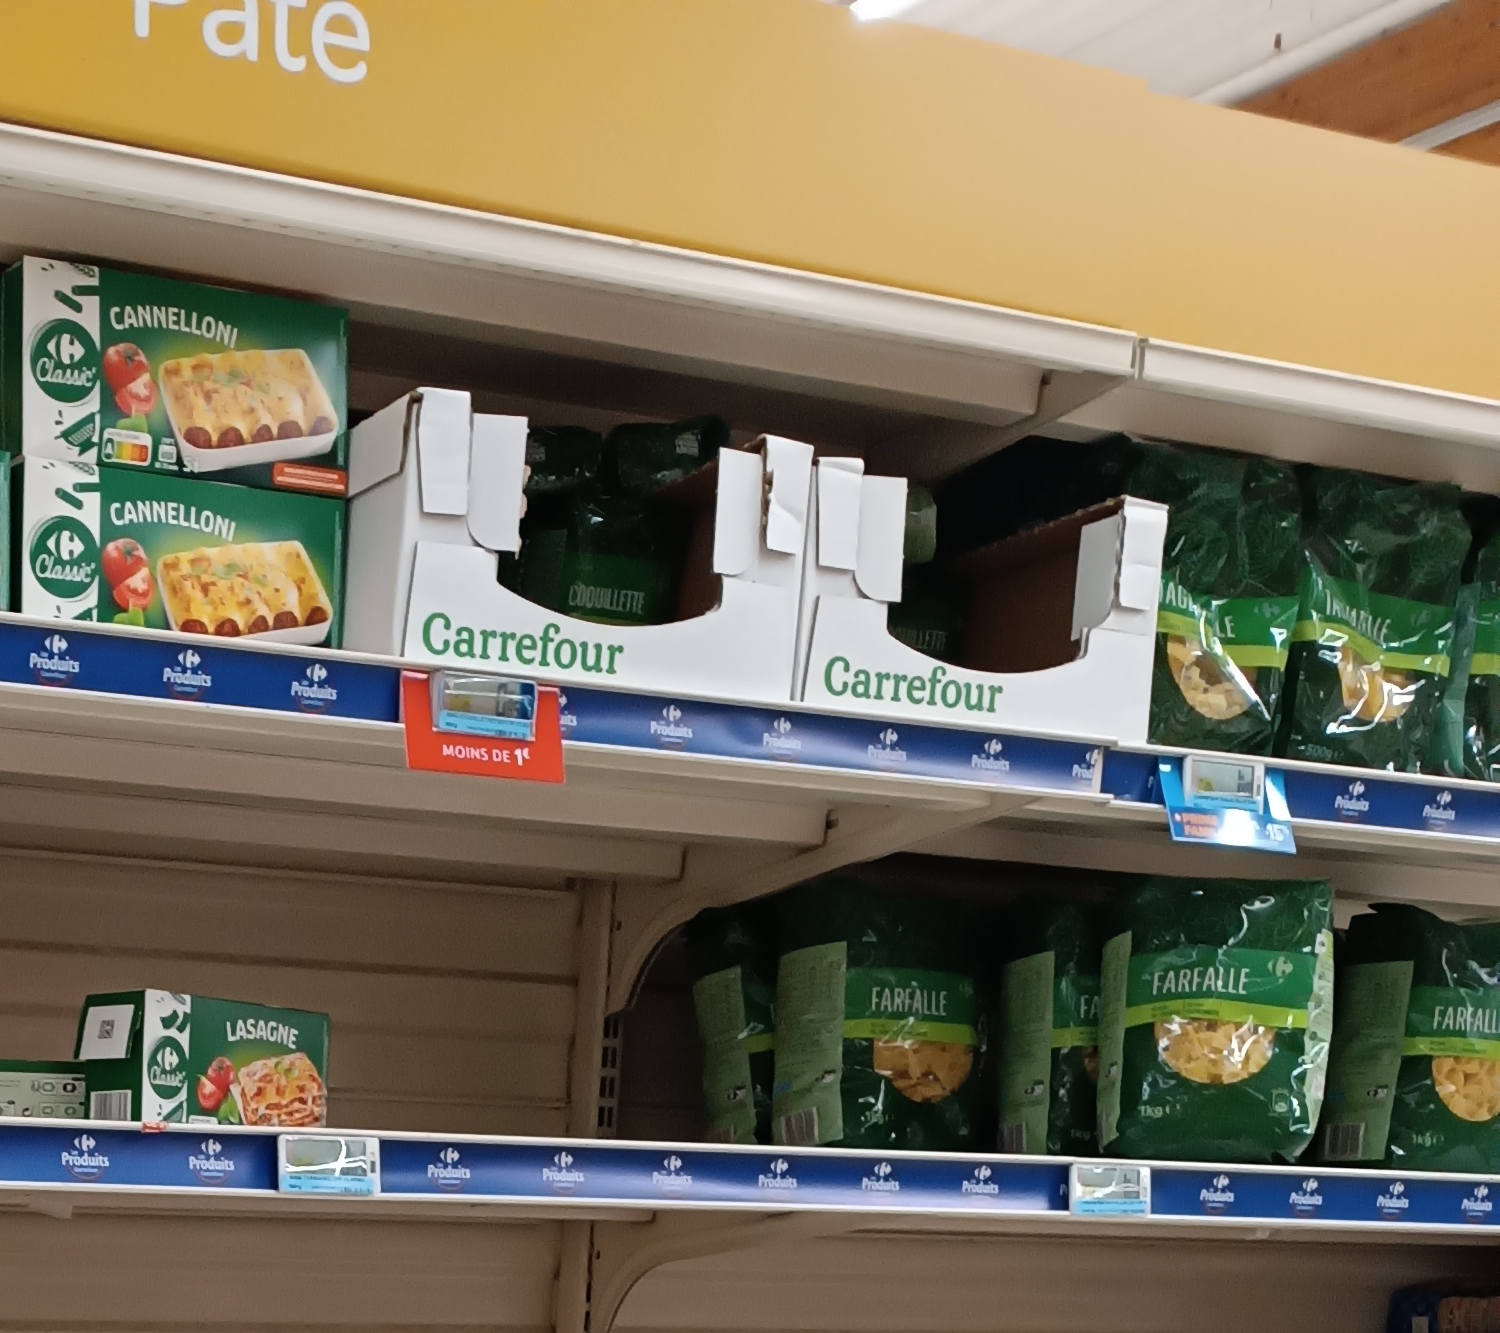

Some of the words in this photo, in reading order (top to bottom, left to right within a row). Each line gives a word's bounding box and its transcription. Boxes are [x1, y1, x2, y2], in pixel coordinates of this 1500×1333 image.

[110, 305, 239, 349] CANNELLONI
[110, 500, 237, 542] CANNELLONI
[422, 612, 624, 676] Carrefour
[29, 652, 80, 674] Produits
[163, 667, 212, 688] Produits
[824, 656, 1004, 714] Carrefour
[291, 681, 338, 701] Produits
[763, 732, 801, 751] Produits
[442, 744, 488, 763] MOINS
[492, 749, 511, 764] DE
[868, 742, 907, 762] Produits
[1151, 966, 1250, 996] FARFALLE
[870, 986, 948, 1018] FARFALLE
[225, 1018, 298, 1049] LASAGNE
[189, 1156, 235, 1173] Produits
[428, 1164, 471, 1180] Produits
[653, 1171, 693, 1187] Produits
[758, 1174, 798, 1190] Produits
[962, 1180, 999, 1196] Produits
